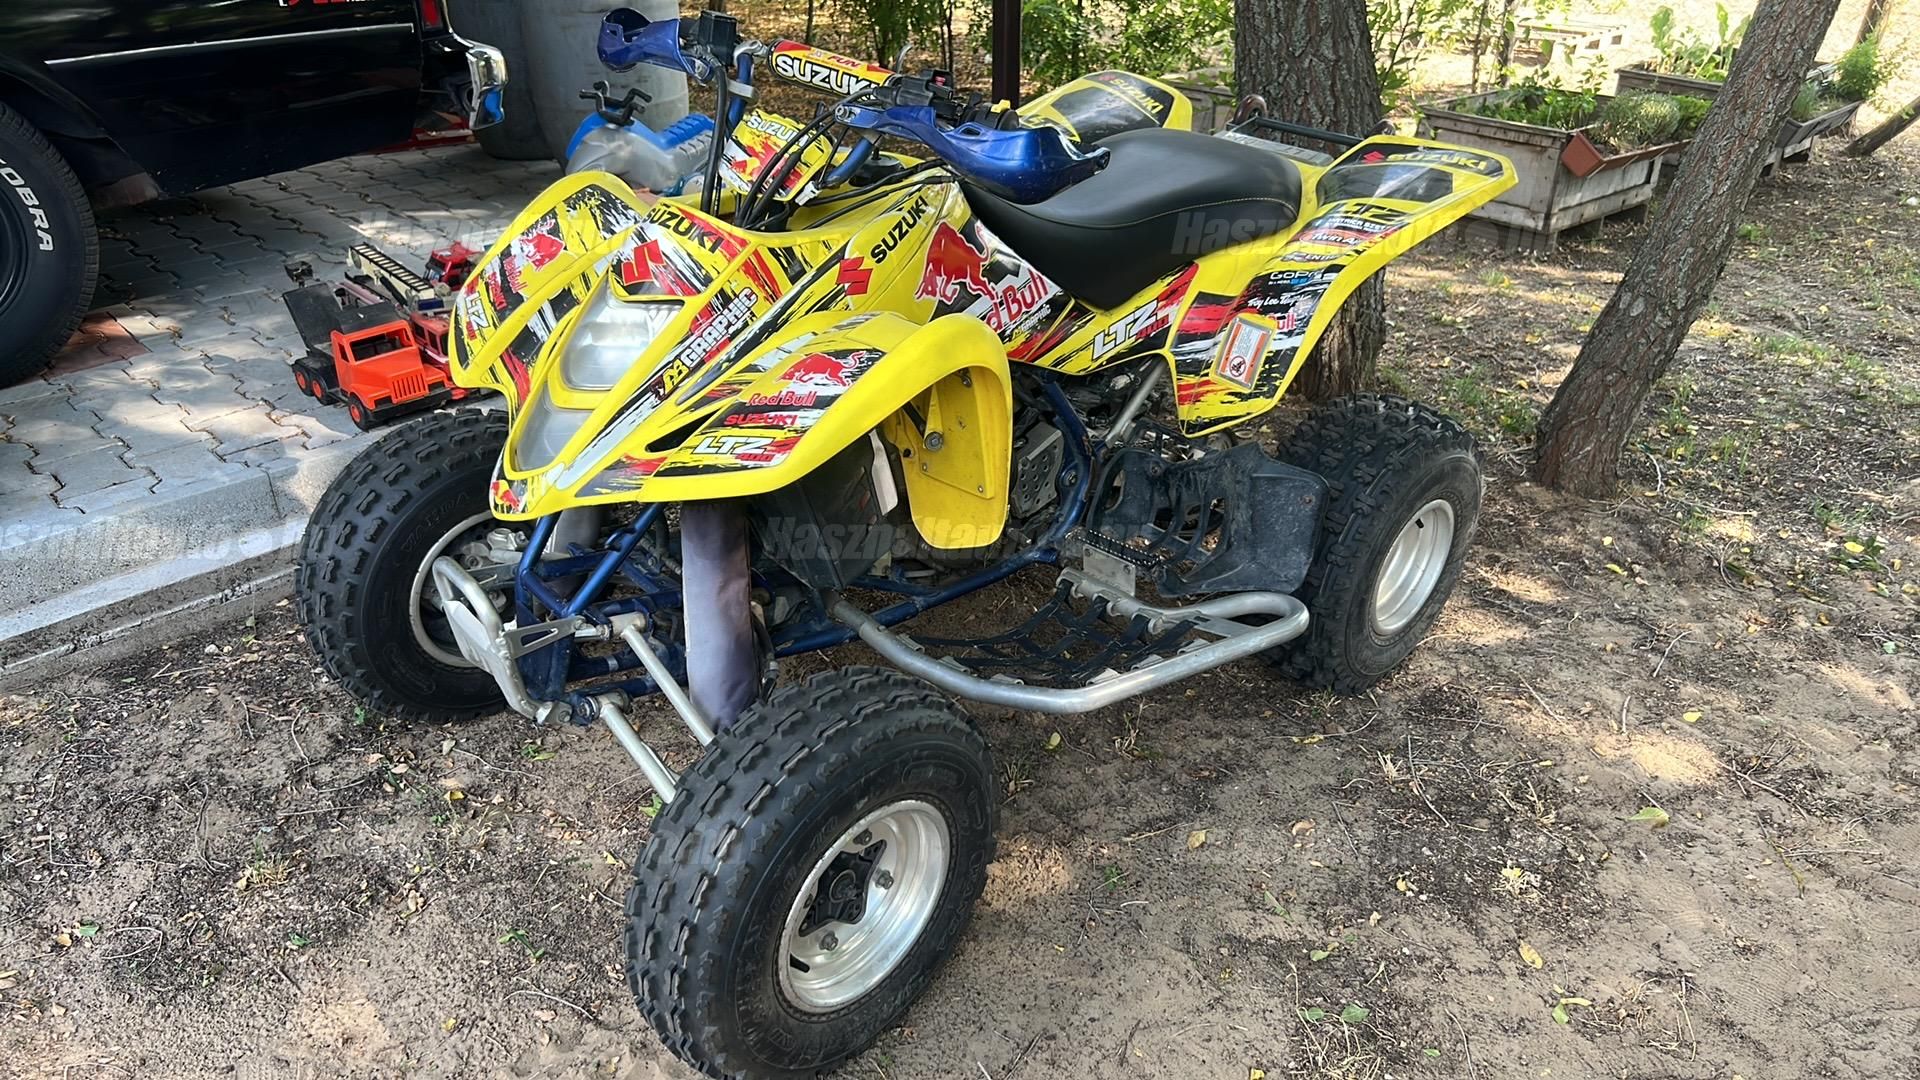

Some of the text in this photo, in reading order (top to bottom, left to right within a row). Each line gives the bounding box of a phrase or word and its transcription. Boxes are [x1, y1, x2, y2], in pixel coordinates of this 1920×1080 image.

[1110, 78, 1164, 114] SUZUKI
[747, 114, 809, 148] SUZU
[1386, 150, 1488, 170] SUZUKI
[0, 158, 54, 251] OBRA
[643, 206, 725, 254] SUZUKI
[870, 196, 929, 264] SUZUKI
[466, 291, 491, 330] LTZ
[1003, 267, 1049, 323] Bull
[681, 287, 758, 367] GRAPHIC
[1091, 299, 1159, 361] LTZ
[746, 390, 818, 407] Red Bull
[724, 413, 798, 427] SUZUKI
[692, 435, 775, 455] LTZ
